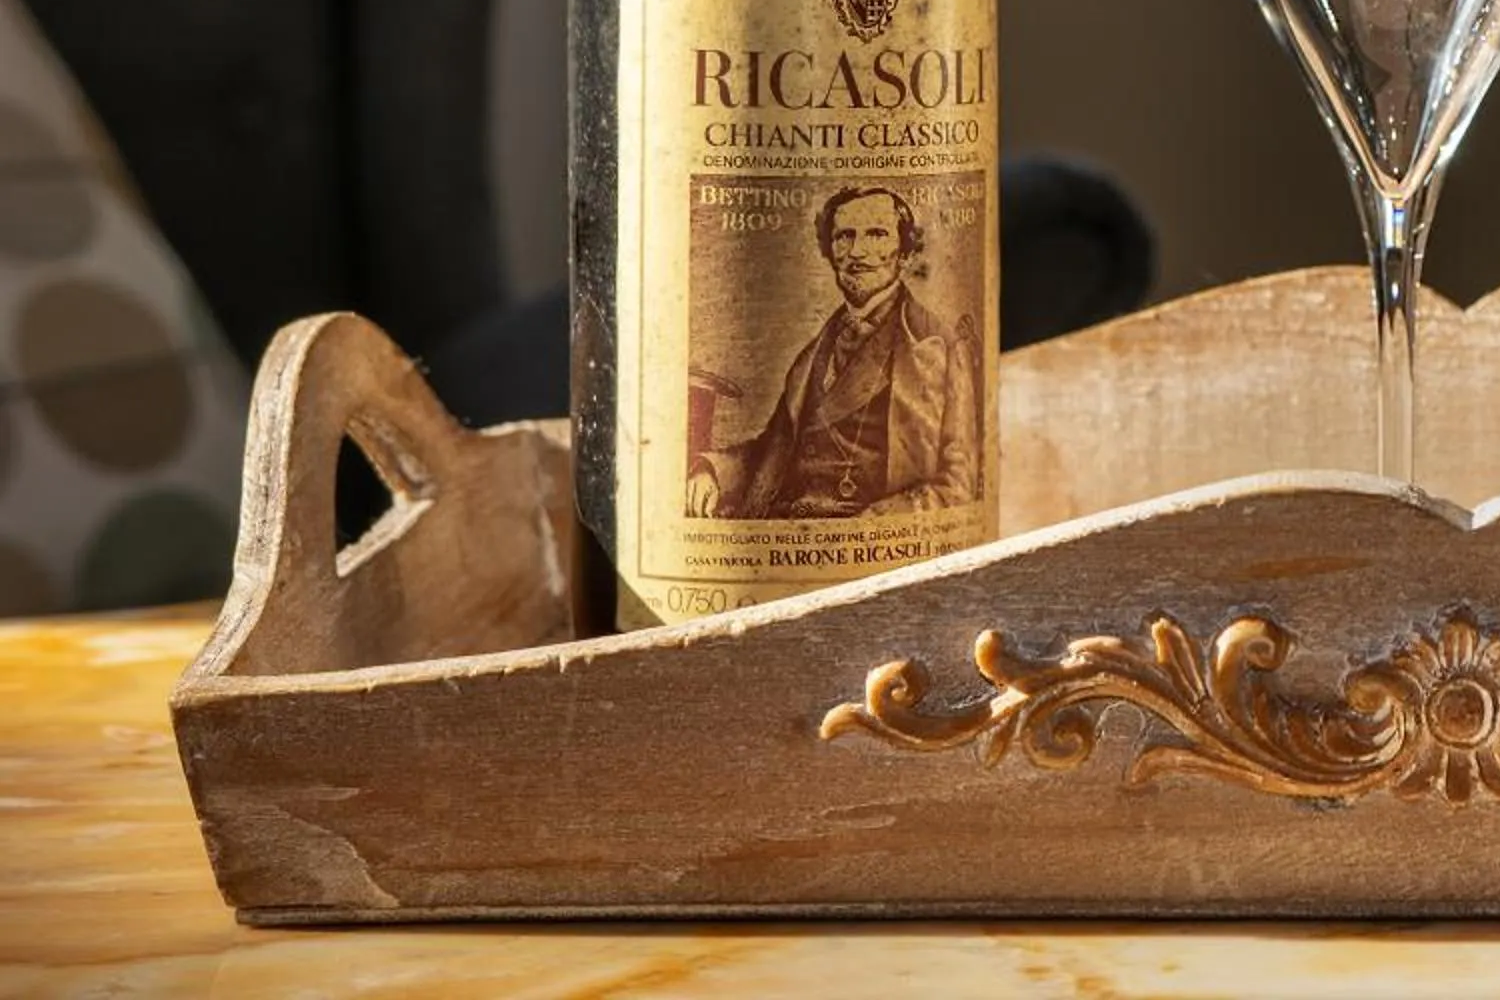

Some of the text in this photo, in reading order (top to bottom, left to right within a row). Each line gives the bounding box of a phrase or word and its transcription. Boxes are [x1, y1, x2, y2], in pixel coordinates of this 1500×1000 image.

[691, 49, 985, 109] RICASOLI
[704, 119, 979, 148] CHIANTI CLASSICO
[703, 154, 828, 169] DENOMINAZIONE
[700, 185, 807, 208] BETTINO
[721, 211, 783, 231] 1809
[775, 533, 811, 545] NELLE
[815, 531, 865, 545] CANTINE
[769, 548, 848, 567] BARONE
[853, 541, 931, 565] RICASOLI
